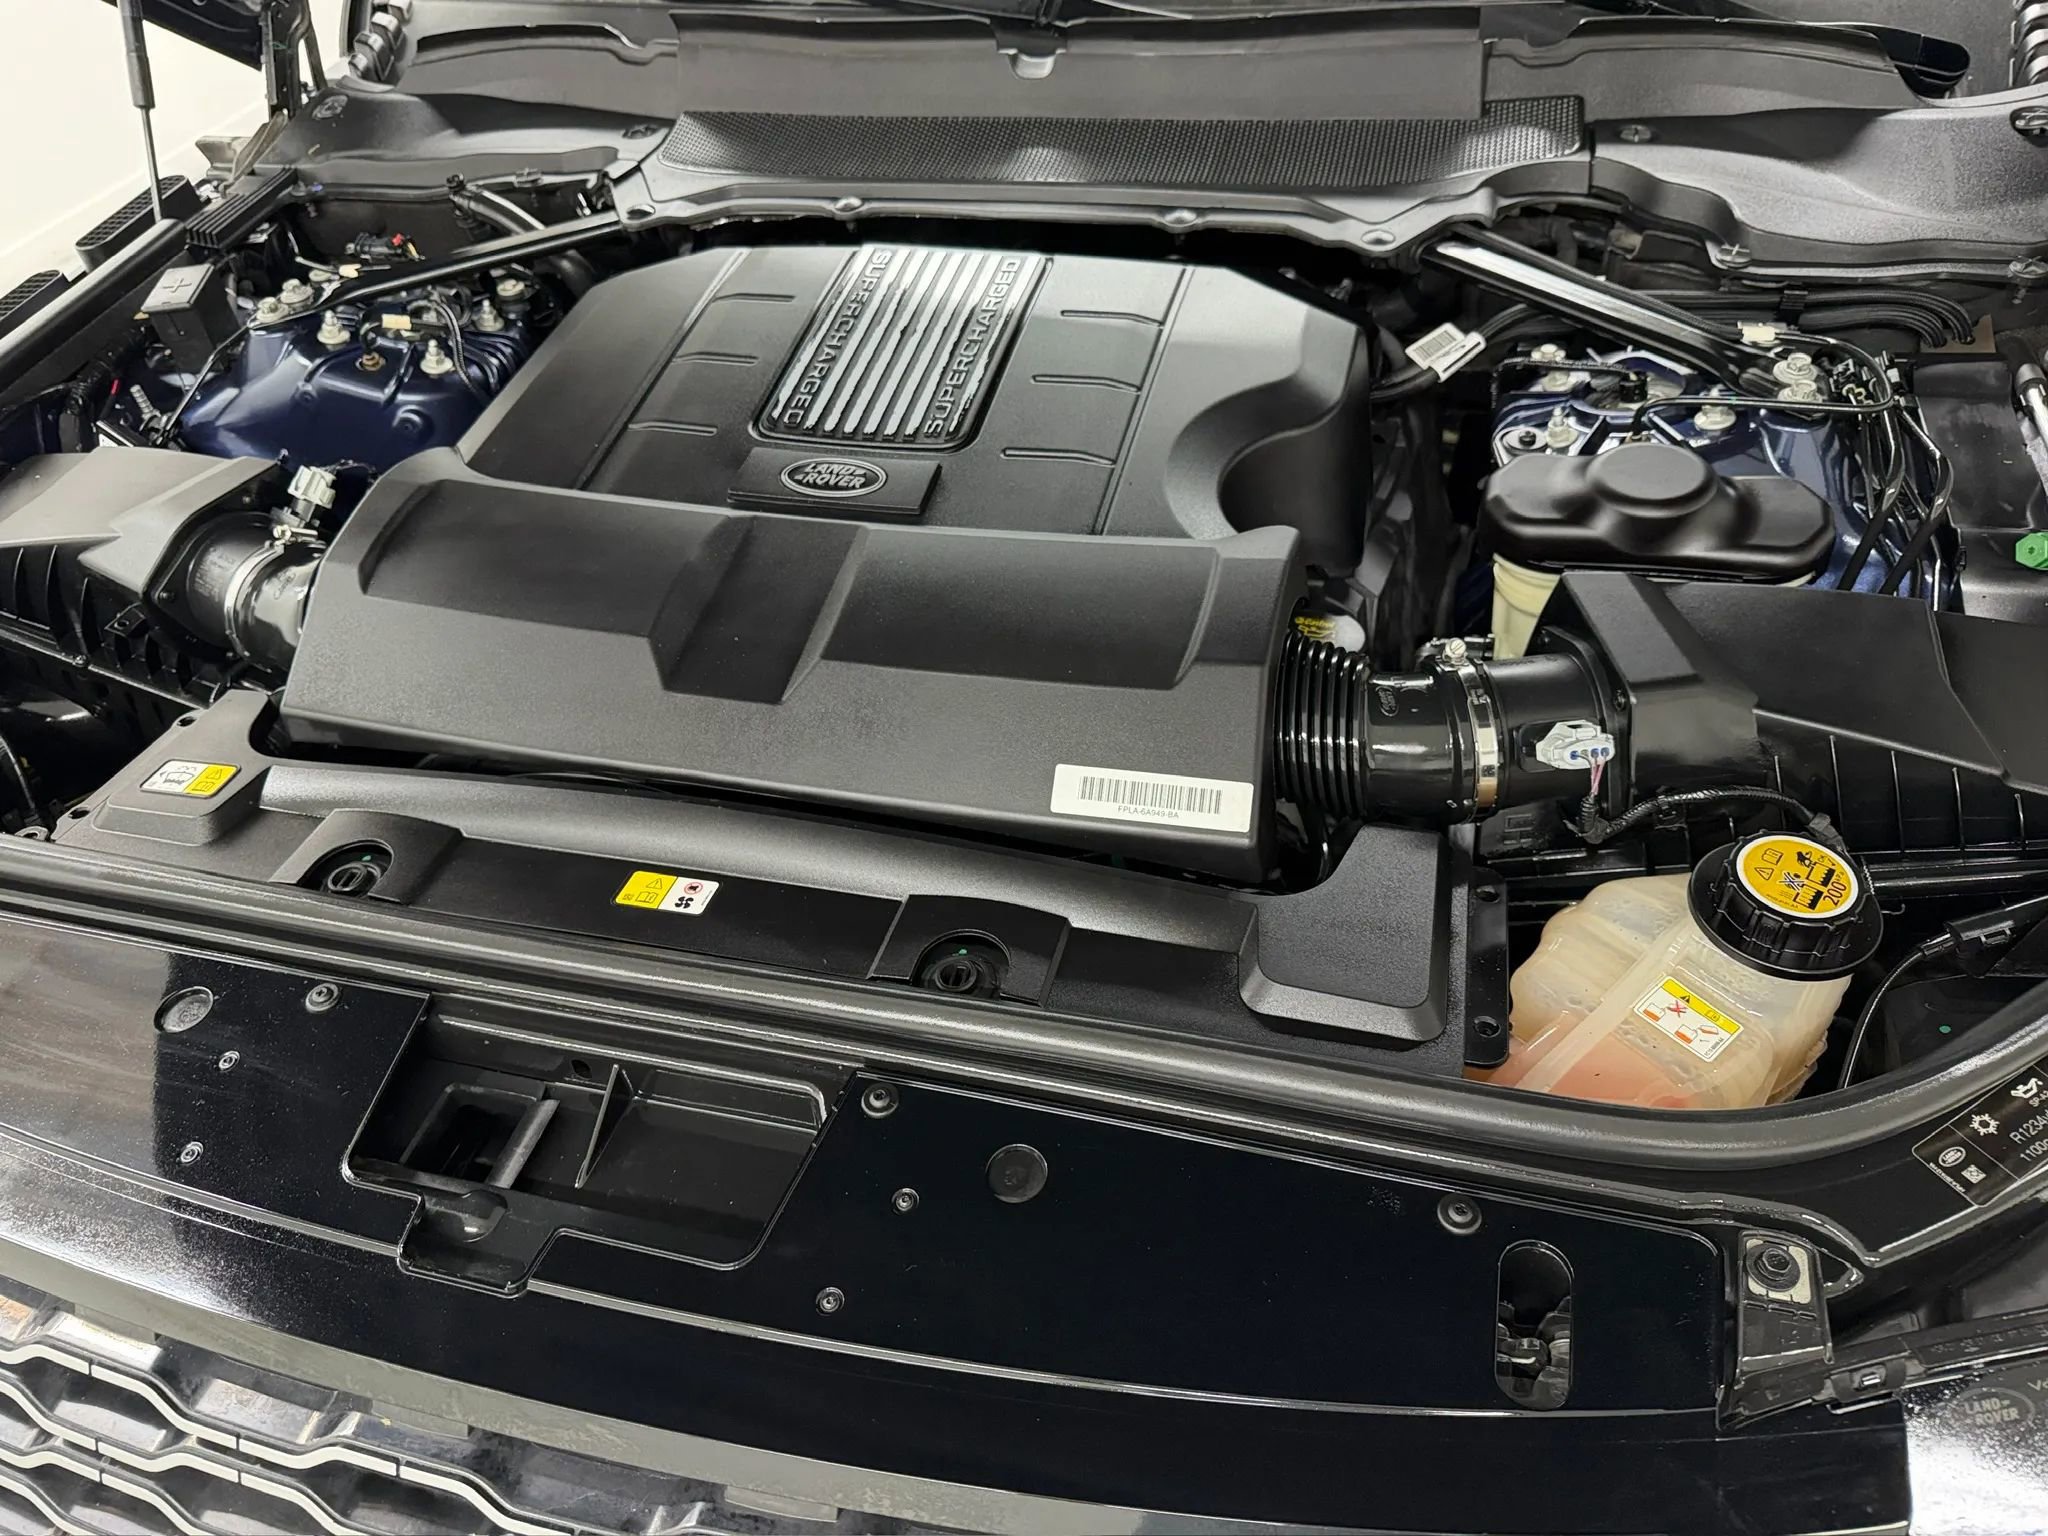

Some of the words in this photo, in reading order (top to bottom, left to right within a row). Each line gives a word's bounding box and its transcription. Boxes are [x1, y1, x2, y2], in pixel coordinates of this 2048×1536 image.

[782, 247, 895, 428] SUPERCHARGED
[924, 257, 1024, 438] SUPERCHARGED
[804, 462, 855, 476] LAND
[802, 472, 866, 489] ROVER
[1822, 880, 1847, 907] 200
[1964, 1397, 2001, 1414] LAND
[1974, 1407, 2020, 1426] ROVER
